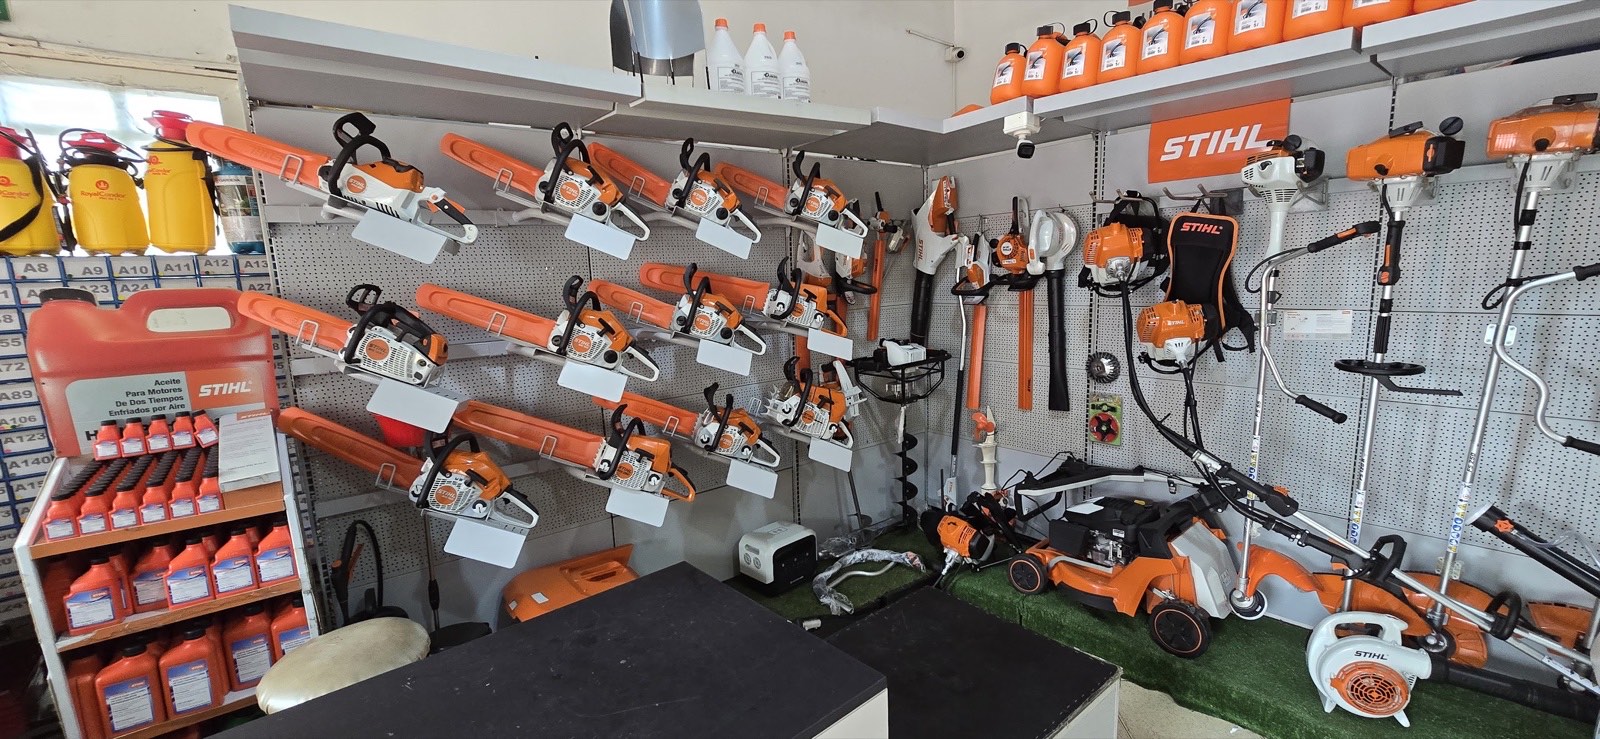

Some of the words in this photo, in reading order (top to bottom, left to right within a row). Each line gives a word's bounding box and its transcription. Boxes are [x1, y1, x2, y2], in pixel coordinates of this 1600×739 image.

[1160, 124, 1273, 162] STIHL
[1180, 222, 1220, 234] STIHL
[23, 263, 48, 272] A8
[164, 263, 190, 272] A11
[244, 260, 268, 268] A13
[82, 266, 103, 276] A9
[119, 266, 148, 274] A10
[0, 338, 22, 348] 55
[148, 388, 182, 396] Motores
[199, 382, 251, 397] STIHL
[0, 390, 32, 400] A89
[148, 396, 184, 404] Tiempos
[109, 406, 150, 416] Enfriados
[0, 415, 36, 425] A106
[4, 433, 46, 444] A123
[9, 456, 50, 470] A140
[15, 480, 44, 492] A15
[1354, 650, 1388, 660] STIHL
